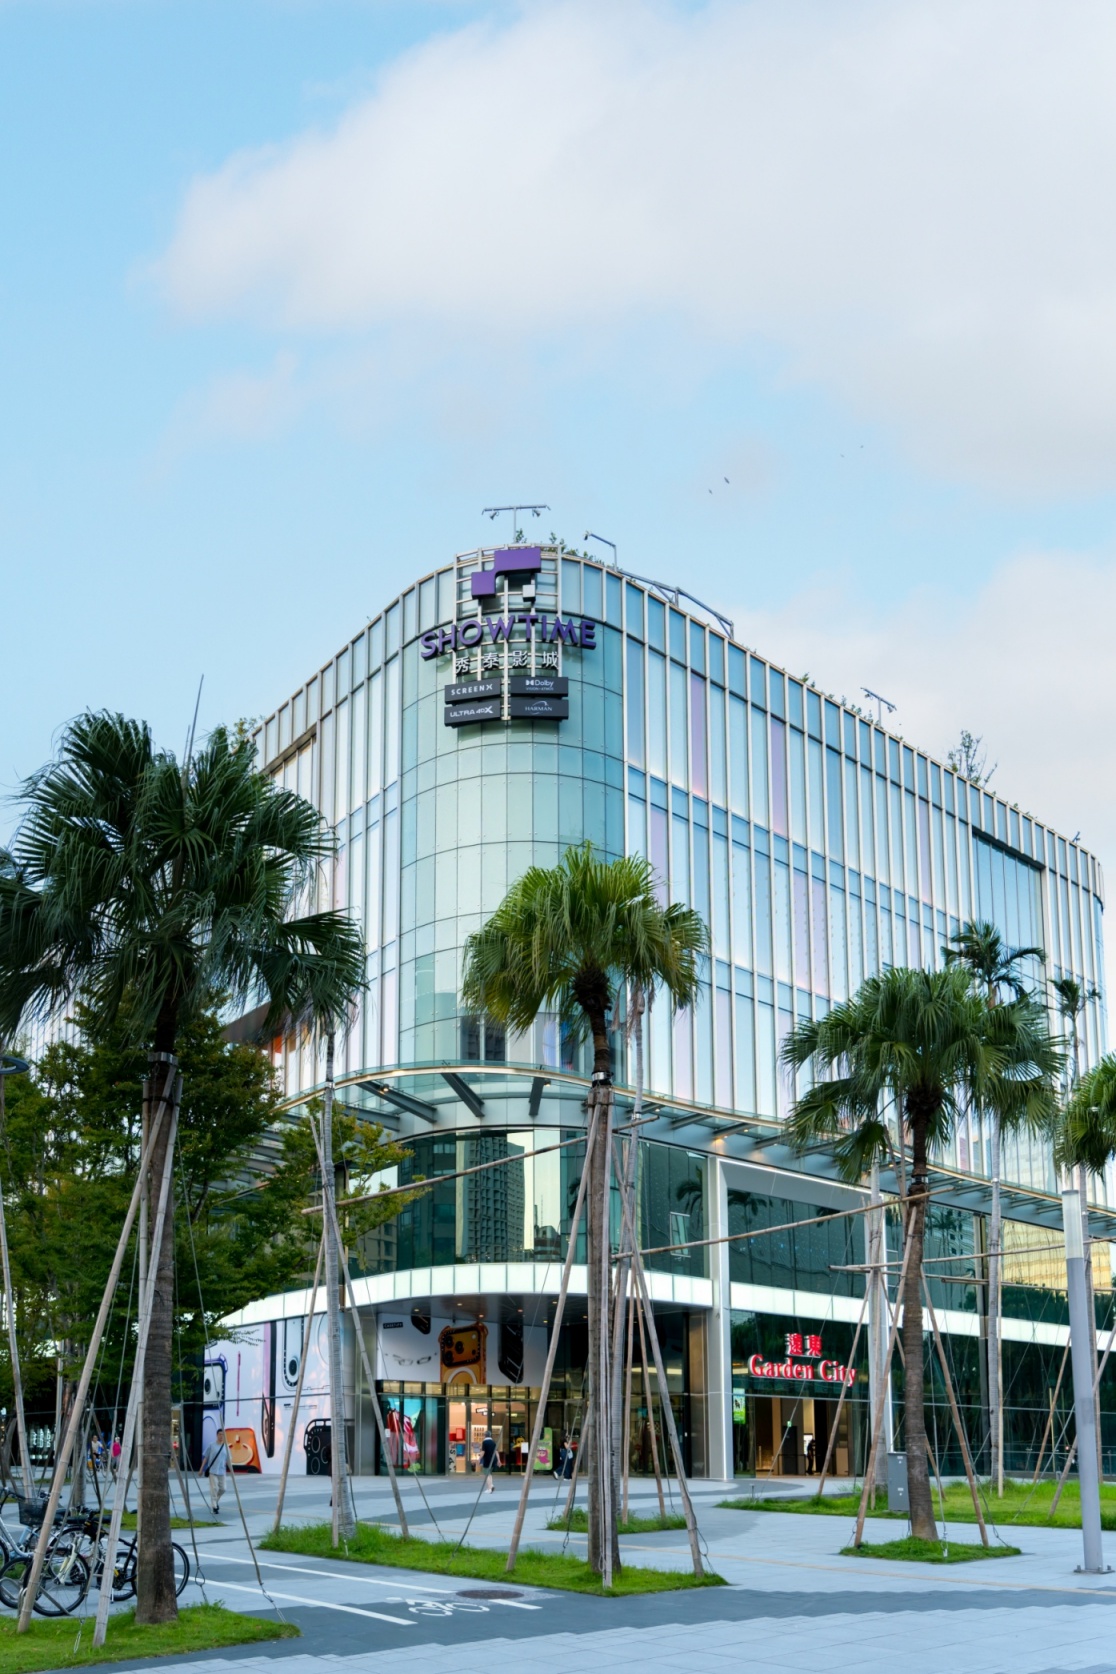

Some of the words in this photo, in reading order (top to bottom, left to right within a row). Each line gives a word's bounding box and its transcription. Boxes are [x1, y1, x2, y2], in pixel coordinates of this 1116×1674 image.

[420, 614, 597, 661] SHOWTIME
[455, 650, 559, 674] 秀泰影城
[451, 683, 493, 696] SCREENX
[534, 679, 554, 687] Dolby
[449, 709, 476, 718] ULTRA
[476, 705, 494, 714] 4DX
[785, 1333, 823, 1357] 遠東
[748, 1353, 814, 1380] Garden
[818, 1360, 857, 1387] City
